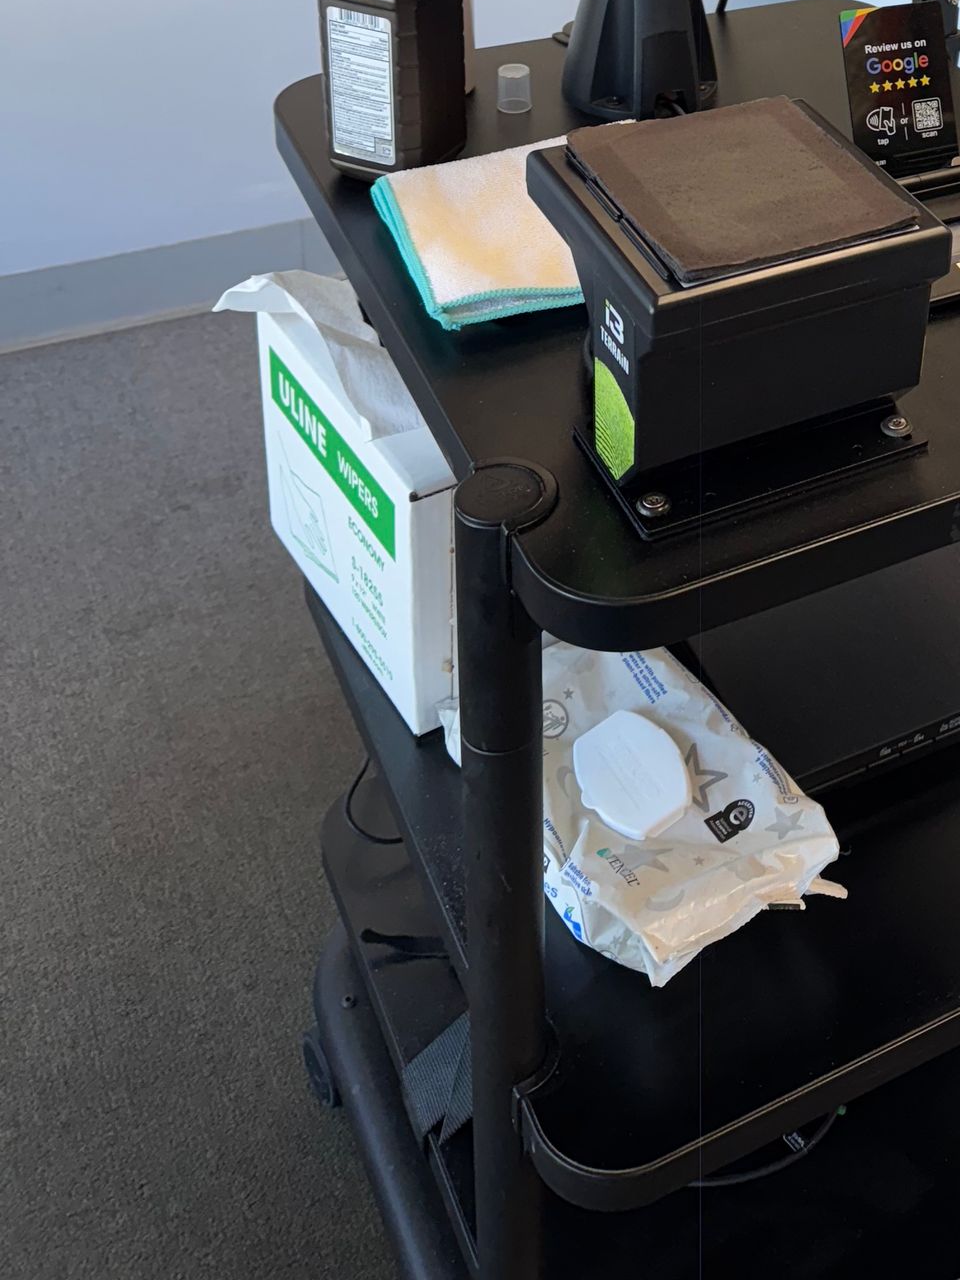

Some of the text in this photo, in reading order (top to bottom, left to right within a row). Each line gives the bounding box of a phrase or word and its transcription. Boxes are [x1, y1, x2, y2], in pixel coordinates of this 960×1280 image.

[865, 39, 927, 54] Review us on
[866, 51, 929, 75] Google
[900, 117, 909, 125] or
[877, 138, 889, 146] tap
[921, 130, 938, 138] scan
[278, 371, 328, 458] ULINE
[337, 449, 379, 519] WIPERS
[348, 516, 385, 572] ECONOMY
